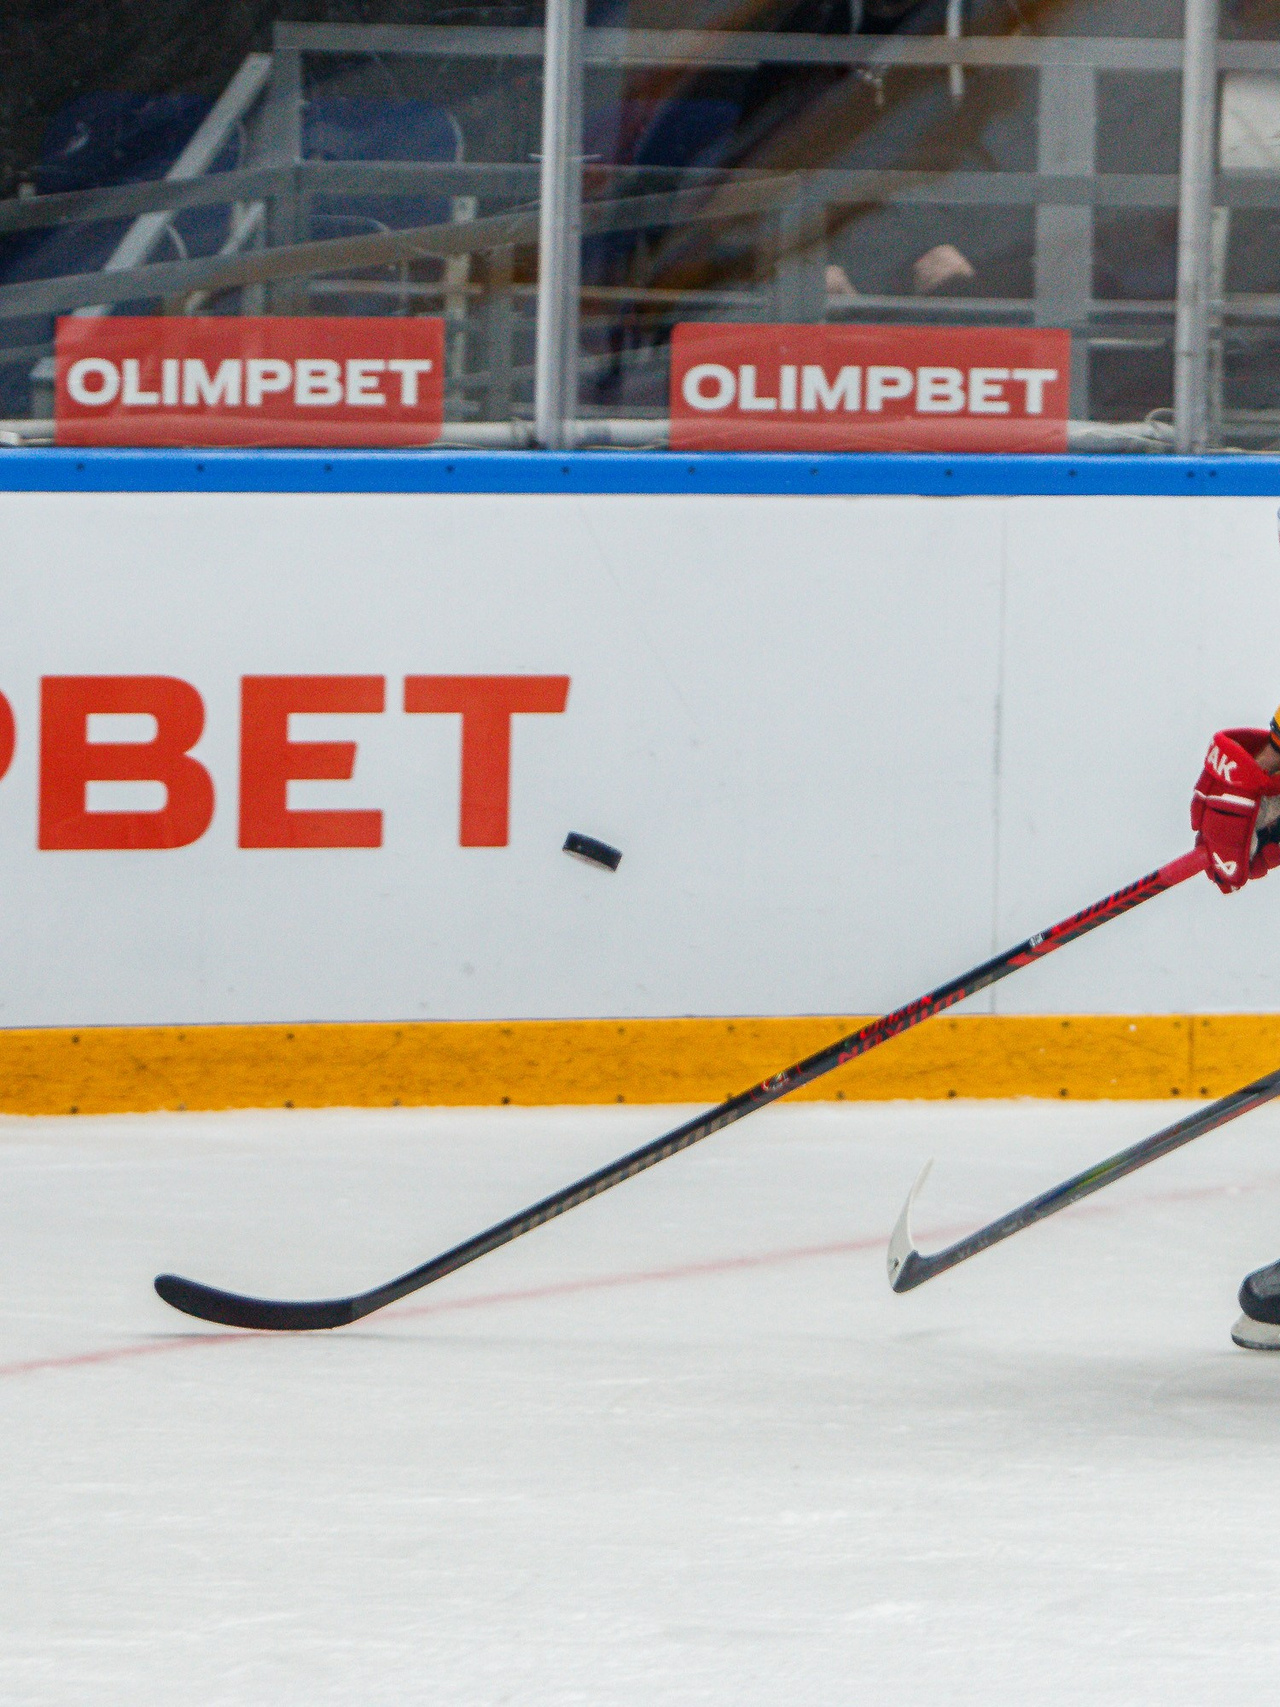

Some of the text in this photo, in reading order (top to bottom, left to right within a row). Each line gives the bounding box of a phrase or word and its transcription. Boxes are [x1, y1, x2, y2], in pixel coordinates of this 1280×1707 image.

[66, 357, 433, 408] OLIMPBET
[682, 363, 1059, 415] OLIMPBET
[0, 675, 571, 850] BET
